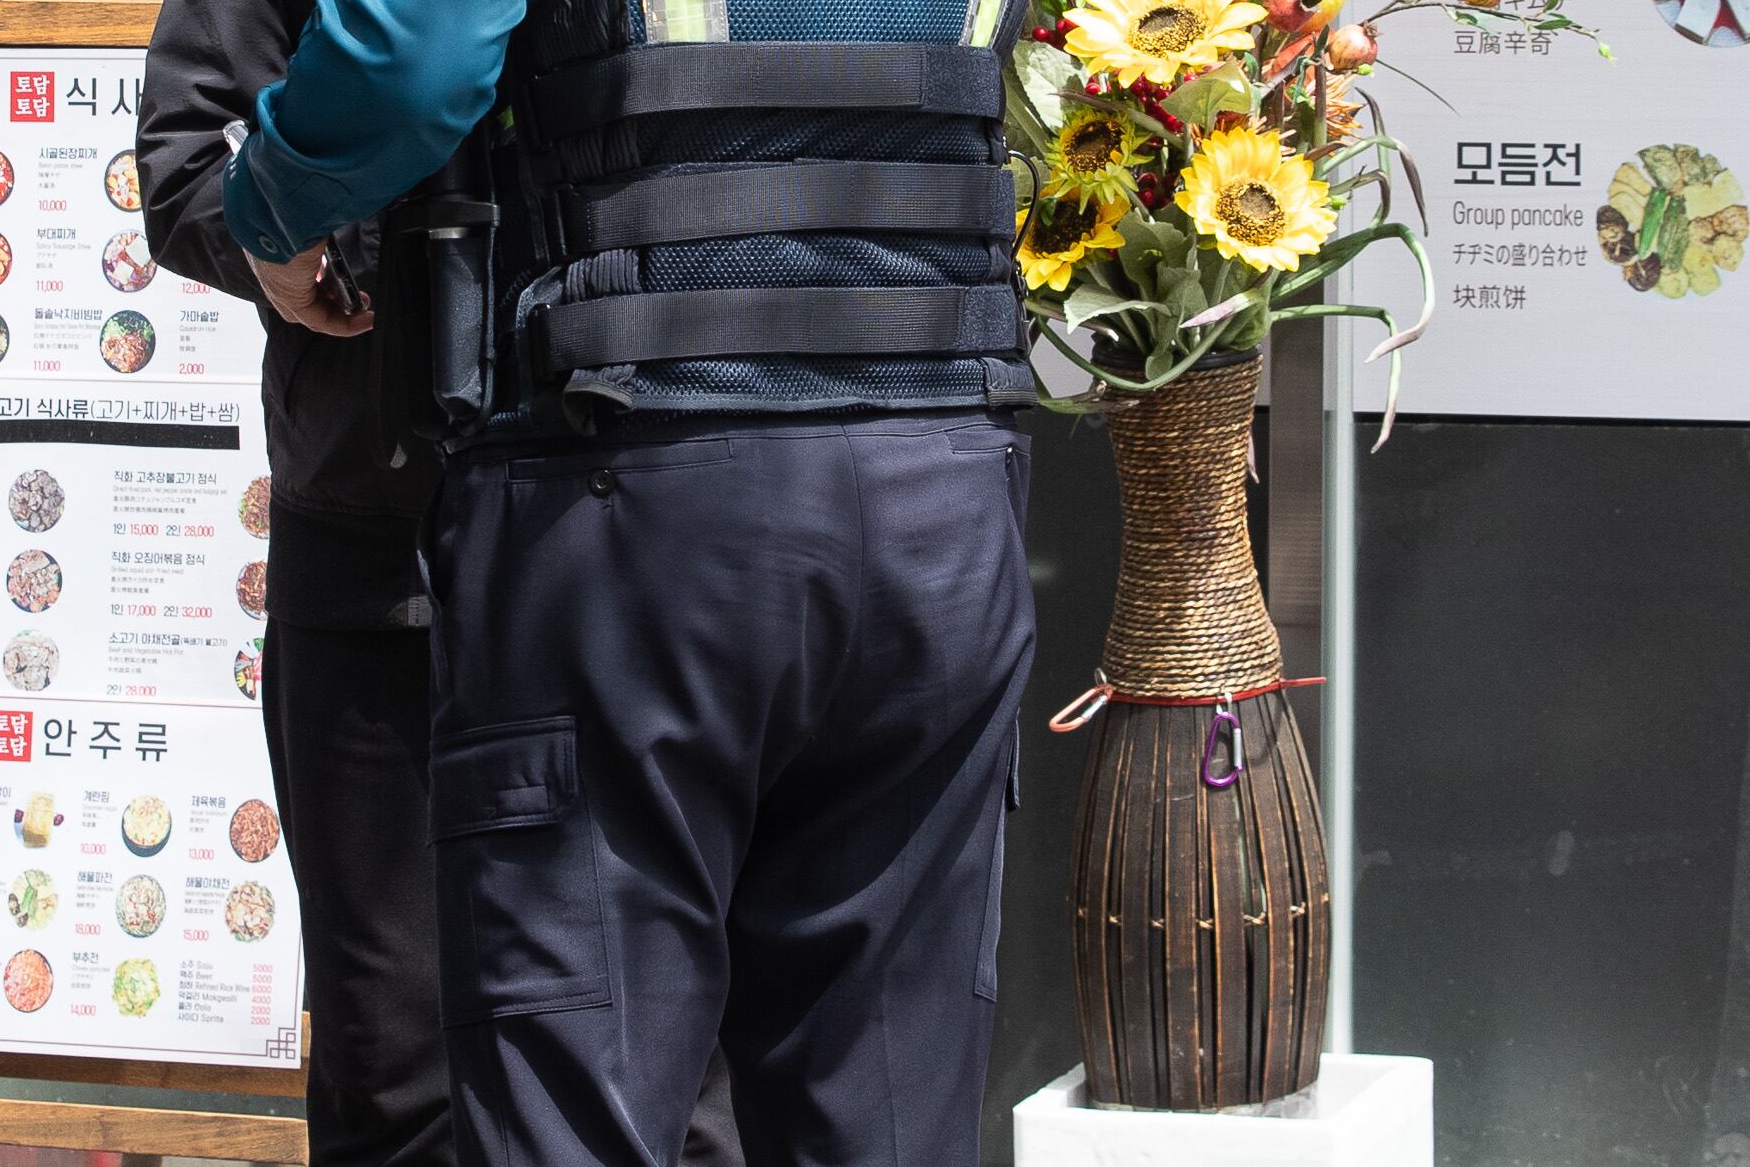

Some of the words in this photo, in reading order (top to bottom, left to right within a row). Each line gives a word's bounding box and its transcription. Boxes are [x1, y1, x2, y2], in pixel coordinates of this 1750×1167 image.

[1454, 29, 1552, 55] 豆腐辛奇
[15, 74, 51, 96] 토담
[15, 96, 51, 118] 토담
[1454, 142, 1582, 187] 모듬전
[38, 200, 67, 211] 10,000
[1453, 200, 1506, 227] Group
[1511, 204, 1584, 230] pancake
[37, 228, 76, 240] 부대찌개
[1453, 242, 1588, 267] チヂミの盛り合わせ
[36, 280, 63, 292] 11,000
[1453, 284, 1527, 310] 块煎饼
[180, 310, 219, 322] 가마솥밥
[34, 360, 61, 372] 11,000
[179, 363, 205, 375] 2,000
[114, 471, 133, 483] 직화
[136, 471, 195, 484] 고추장불고기
[198, 473, 217, 485] 정식
[113, 523, 126, 535] 1인
[130, 524, 159, 536] 15,000
[166, 524, 181, 537] 2인
[184, 526, 215, 538] 28,000
[111, 551, 131, 563] 직화
[134, 552, 183, 565] 오징어볶음
[186, 553, 205, 566] 정식
[111, 603, 124, 615] 1인
[127, 604, 156, 617] 17,000
[163, 605, 179, 617] 2인
[182, 606, 213, 618] 32,000
[109, 632, 138, 644] 소고기
[192, 795, 226, 808] 제육볶음
[81, 843, 106, 855] 10,000
[189, 848, 214, 860] 13,000
[77, 870, 113, 884] 해물파전
[75, 923, 101, 935] 18,000
[184, 929, 209, 941] 15,000
[72, 952, 99, 964] 부추전
[71, 1004, 96, 1016] 14,000
